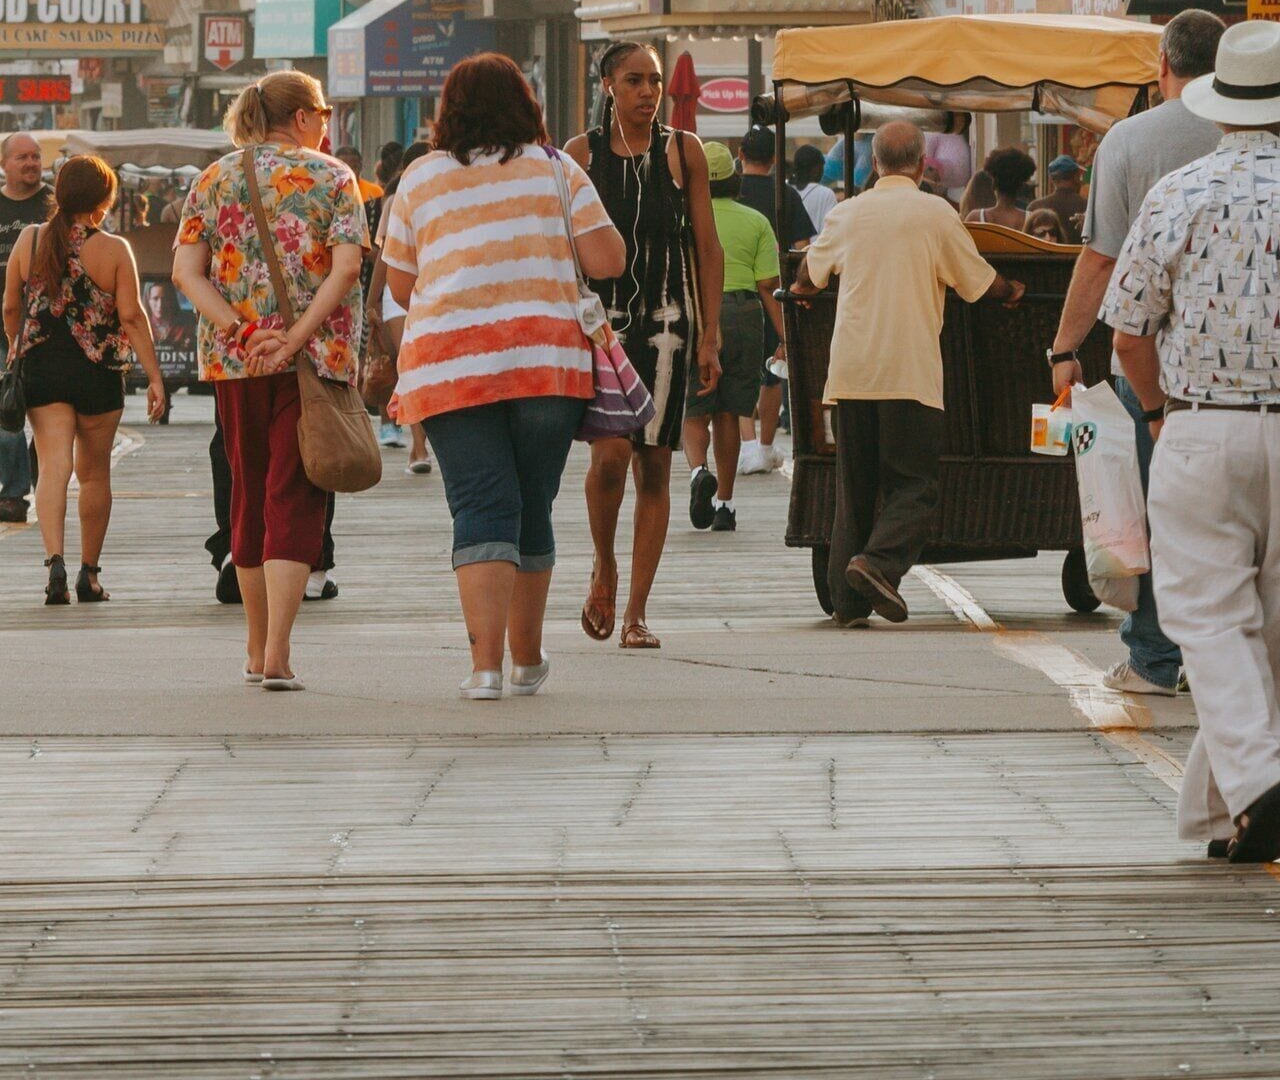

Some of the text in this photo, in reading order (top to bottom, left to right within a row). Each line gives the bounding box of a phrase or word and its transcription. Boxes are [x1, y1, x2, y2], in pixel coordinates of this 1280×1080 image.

[14, 29, 49, 43] CAKE
[60, 29, 113, 42] SALADS
[122, 30, 161, 44] PIZZA
[207, 22, 242, 44] ATM
[422, 56, 445, 65] ATM
[18, 79, 71, 102] SUBS
[702, 89, 720, 99] Pick
[722, 89, 734, 101] Up
